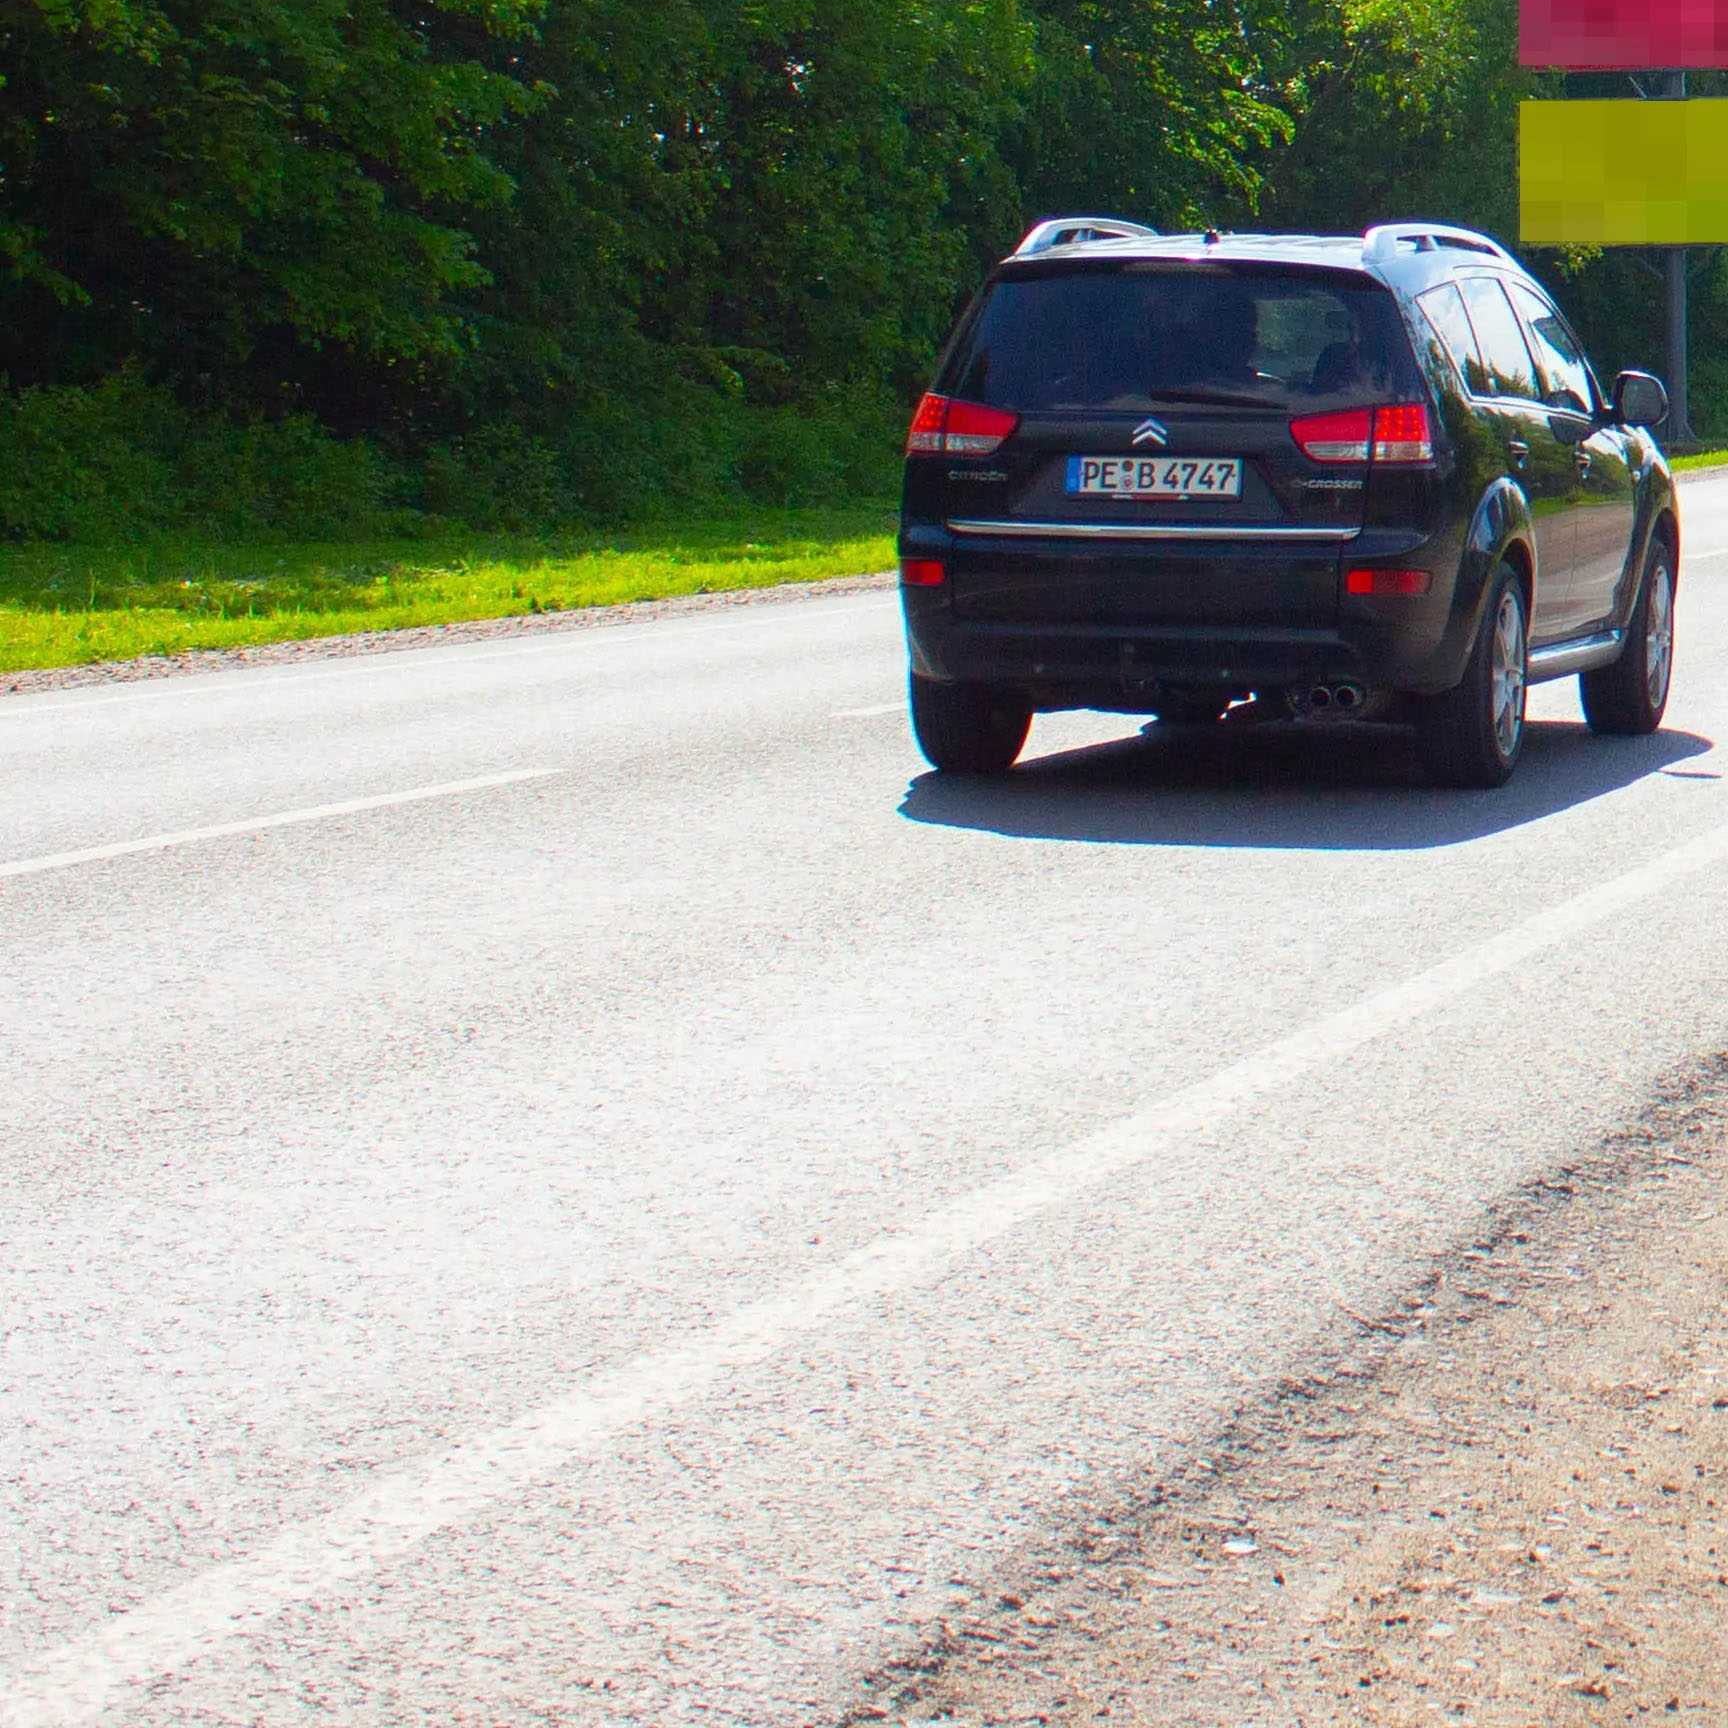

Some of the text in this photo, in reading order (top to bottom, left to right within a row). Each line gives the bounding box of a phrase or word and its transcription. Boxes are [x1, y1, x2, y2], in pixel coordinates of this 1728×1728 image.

[1083, 461, 1235, 490] PE B 4747
